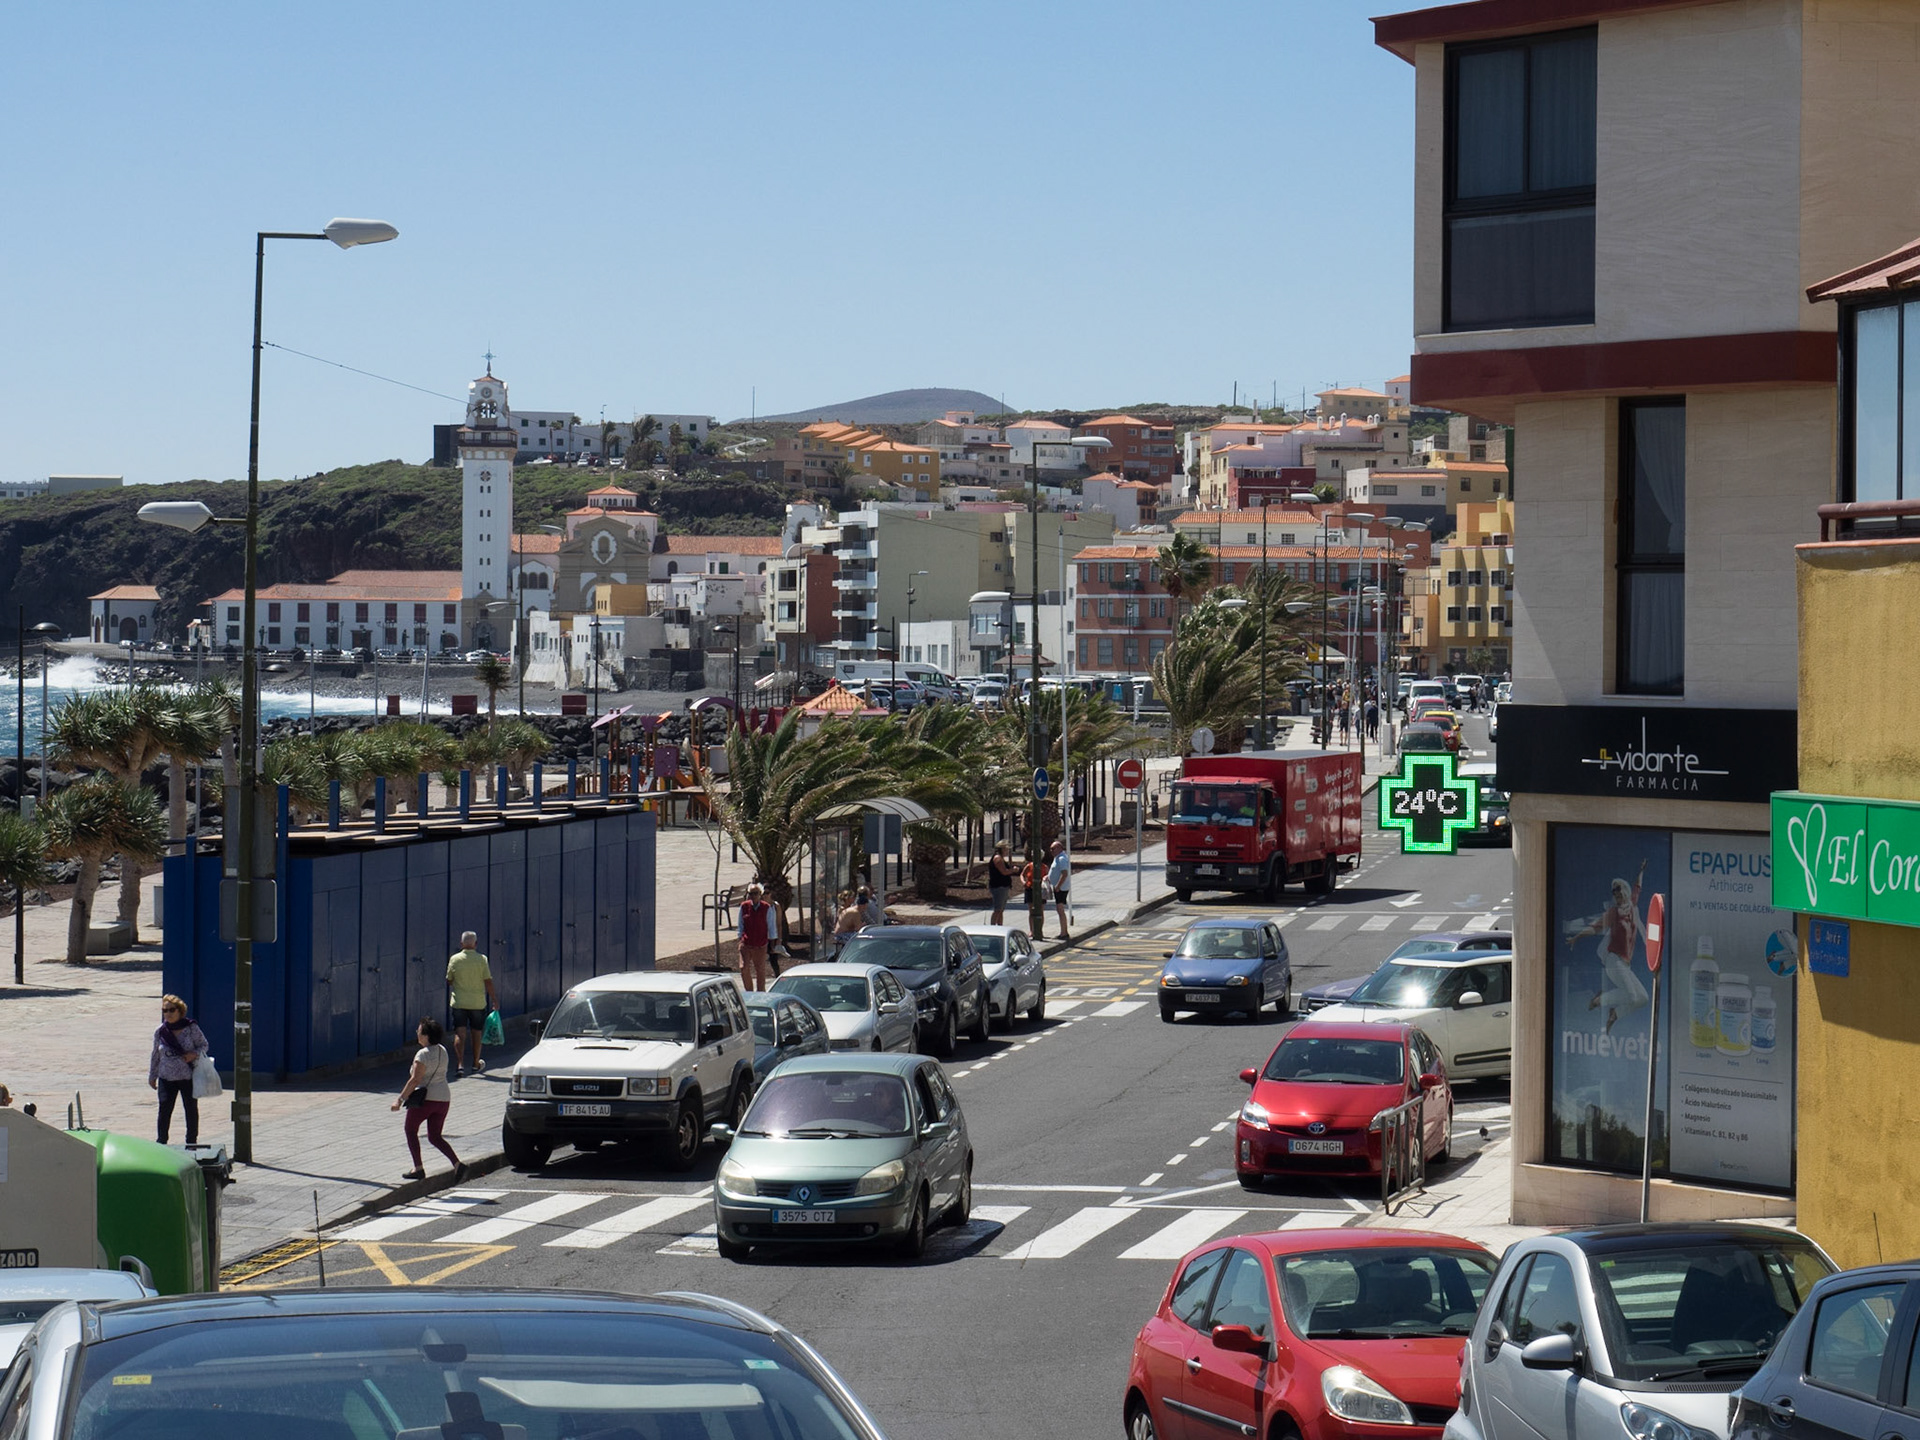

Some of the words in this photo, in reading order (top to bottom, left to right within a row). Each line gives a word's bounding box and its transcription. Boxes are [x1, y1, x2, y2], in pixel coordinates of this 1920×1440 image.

[1616, 775, 1699, 791] FARMACIA
[1828, 829, 1865, 886] El
[1689, 850, 1771, 878] EPAPLUS
[1708, 879, 1754, 893] Arthicare
[1703, 902, 1728, 912] VENTAS
[1729, 903, 1738, 912] DE
[1120, 932, 1182, 940] US
[1043, 987, 1119, 997] BU
[564, 1105, 574, 1115] TF
[576, 1105, 597, 1115] 8415
[599, 1106, 610, 1115] AU
[1295, 1141, 1320, 1151] 0674
[1322, 1142, 1341, 1152] HGH
[781, 1211, 808, 1222] 3575
[813, 1211, 834, 1222] CTZ
